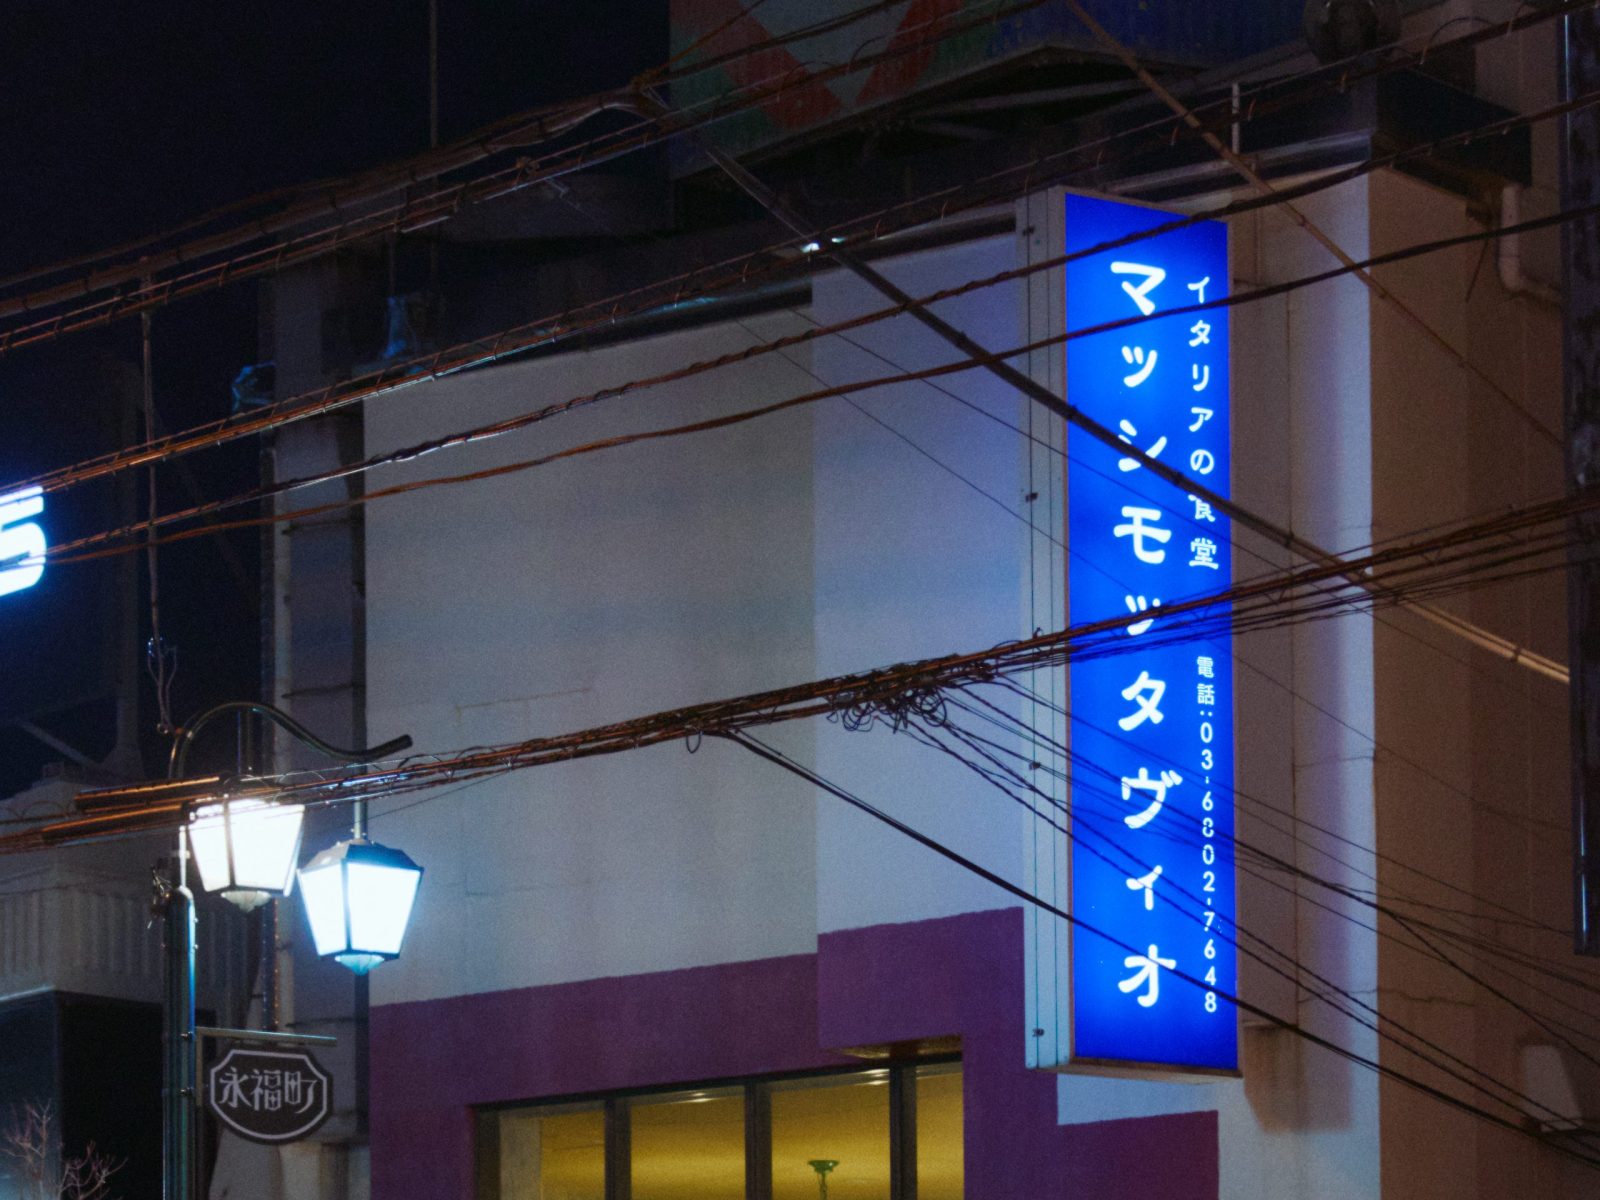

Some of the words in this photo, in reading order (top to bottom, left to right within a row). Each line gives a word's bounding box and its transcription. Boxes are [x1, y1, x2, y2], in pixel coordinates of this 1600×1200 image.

[1110, 261, 1182, 1007] マッシモッタヴィオ
[219, 1066, 318, 1114] 永福町
